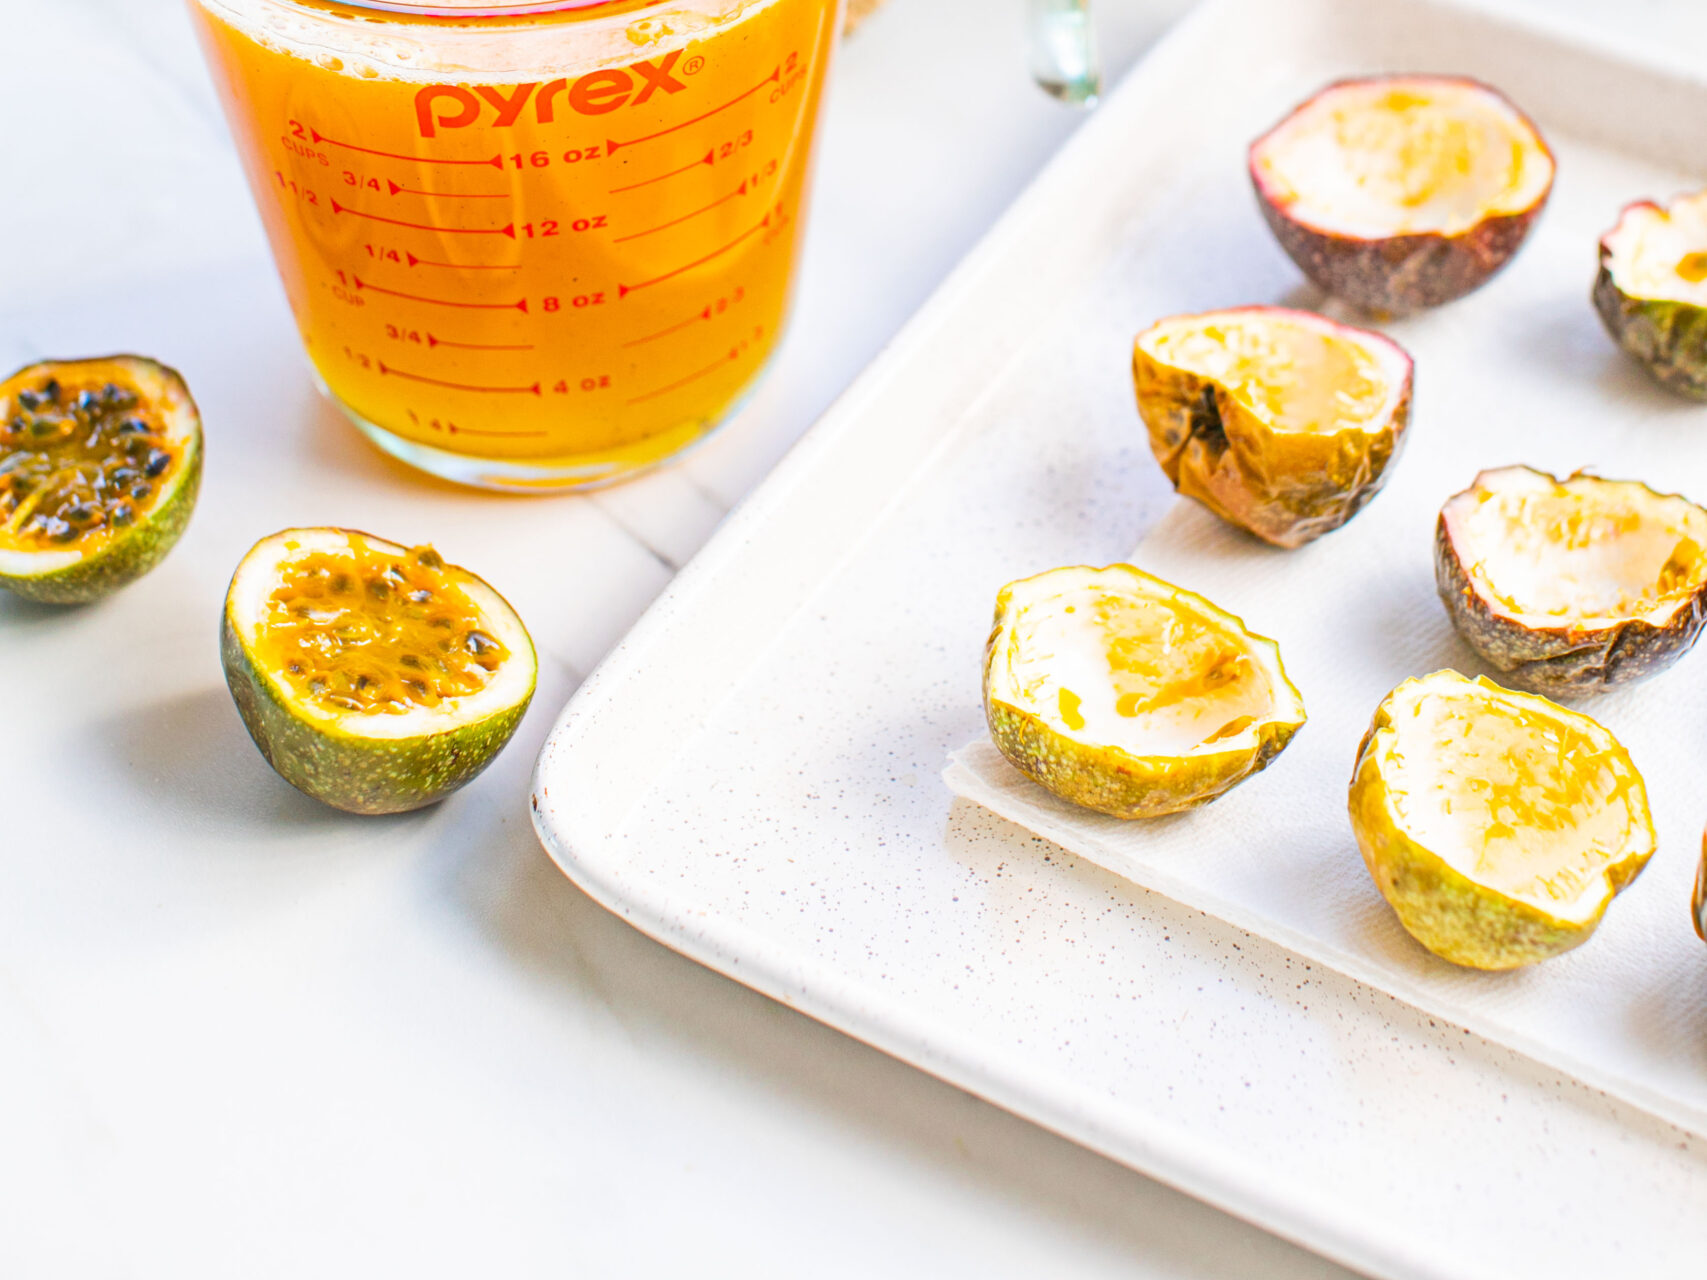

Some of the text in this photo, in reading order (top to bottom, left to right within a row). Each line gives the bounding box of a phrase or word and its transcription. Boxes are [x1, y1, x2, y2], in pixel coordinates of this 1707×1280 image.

[785, 51, 798, 74] 2
[289, 119, 307, 141] 2
[720, 129, 753, 159] 2/3
[510, 145, 601, 170] 16 oz
[342, 171, 380, 191] 3/4
[521, 215, 608, 239] 12 oz
[364, 244, 401, 263] 1/4
[336, 269, 348, 287] 1
[543, 292, 606, 313] 8 oz
[716, 286, 745, 315] 23
[344, 346, 370, 370] 12
